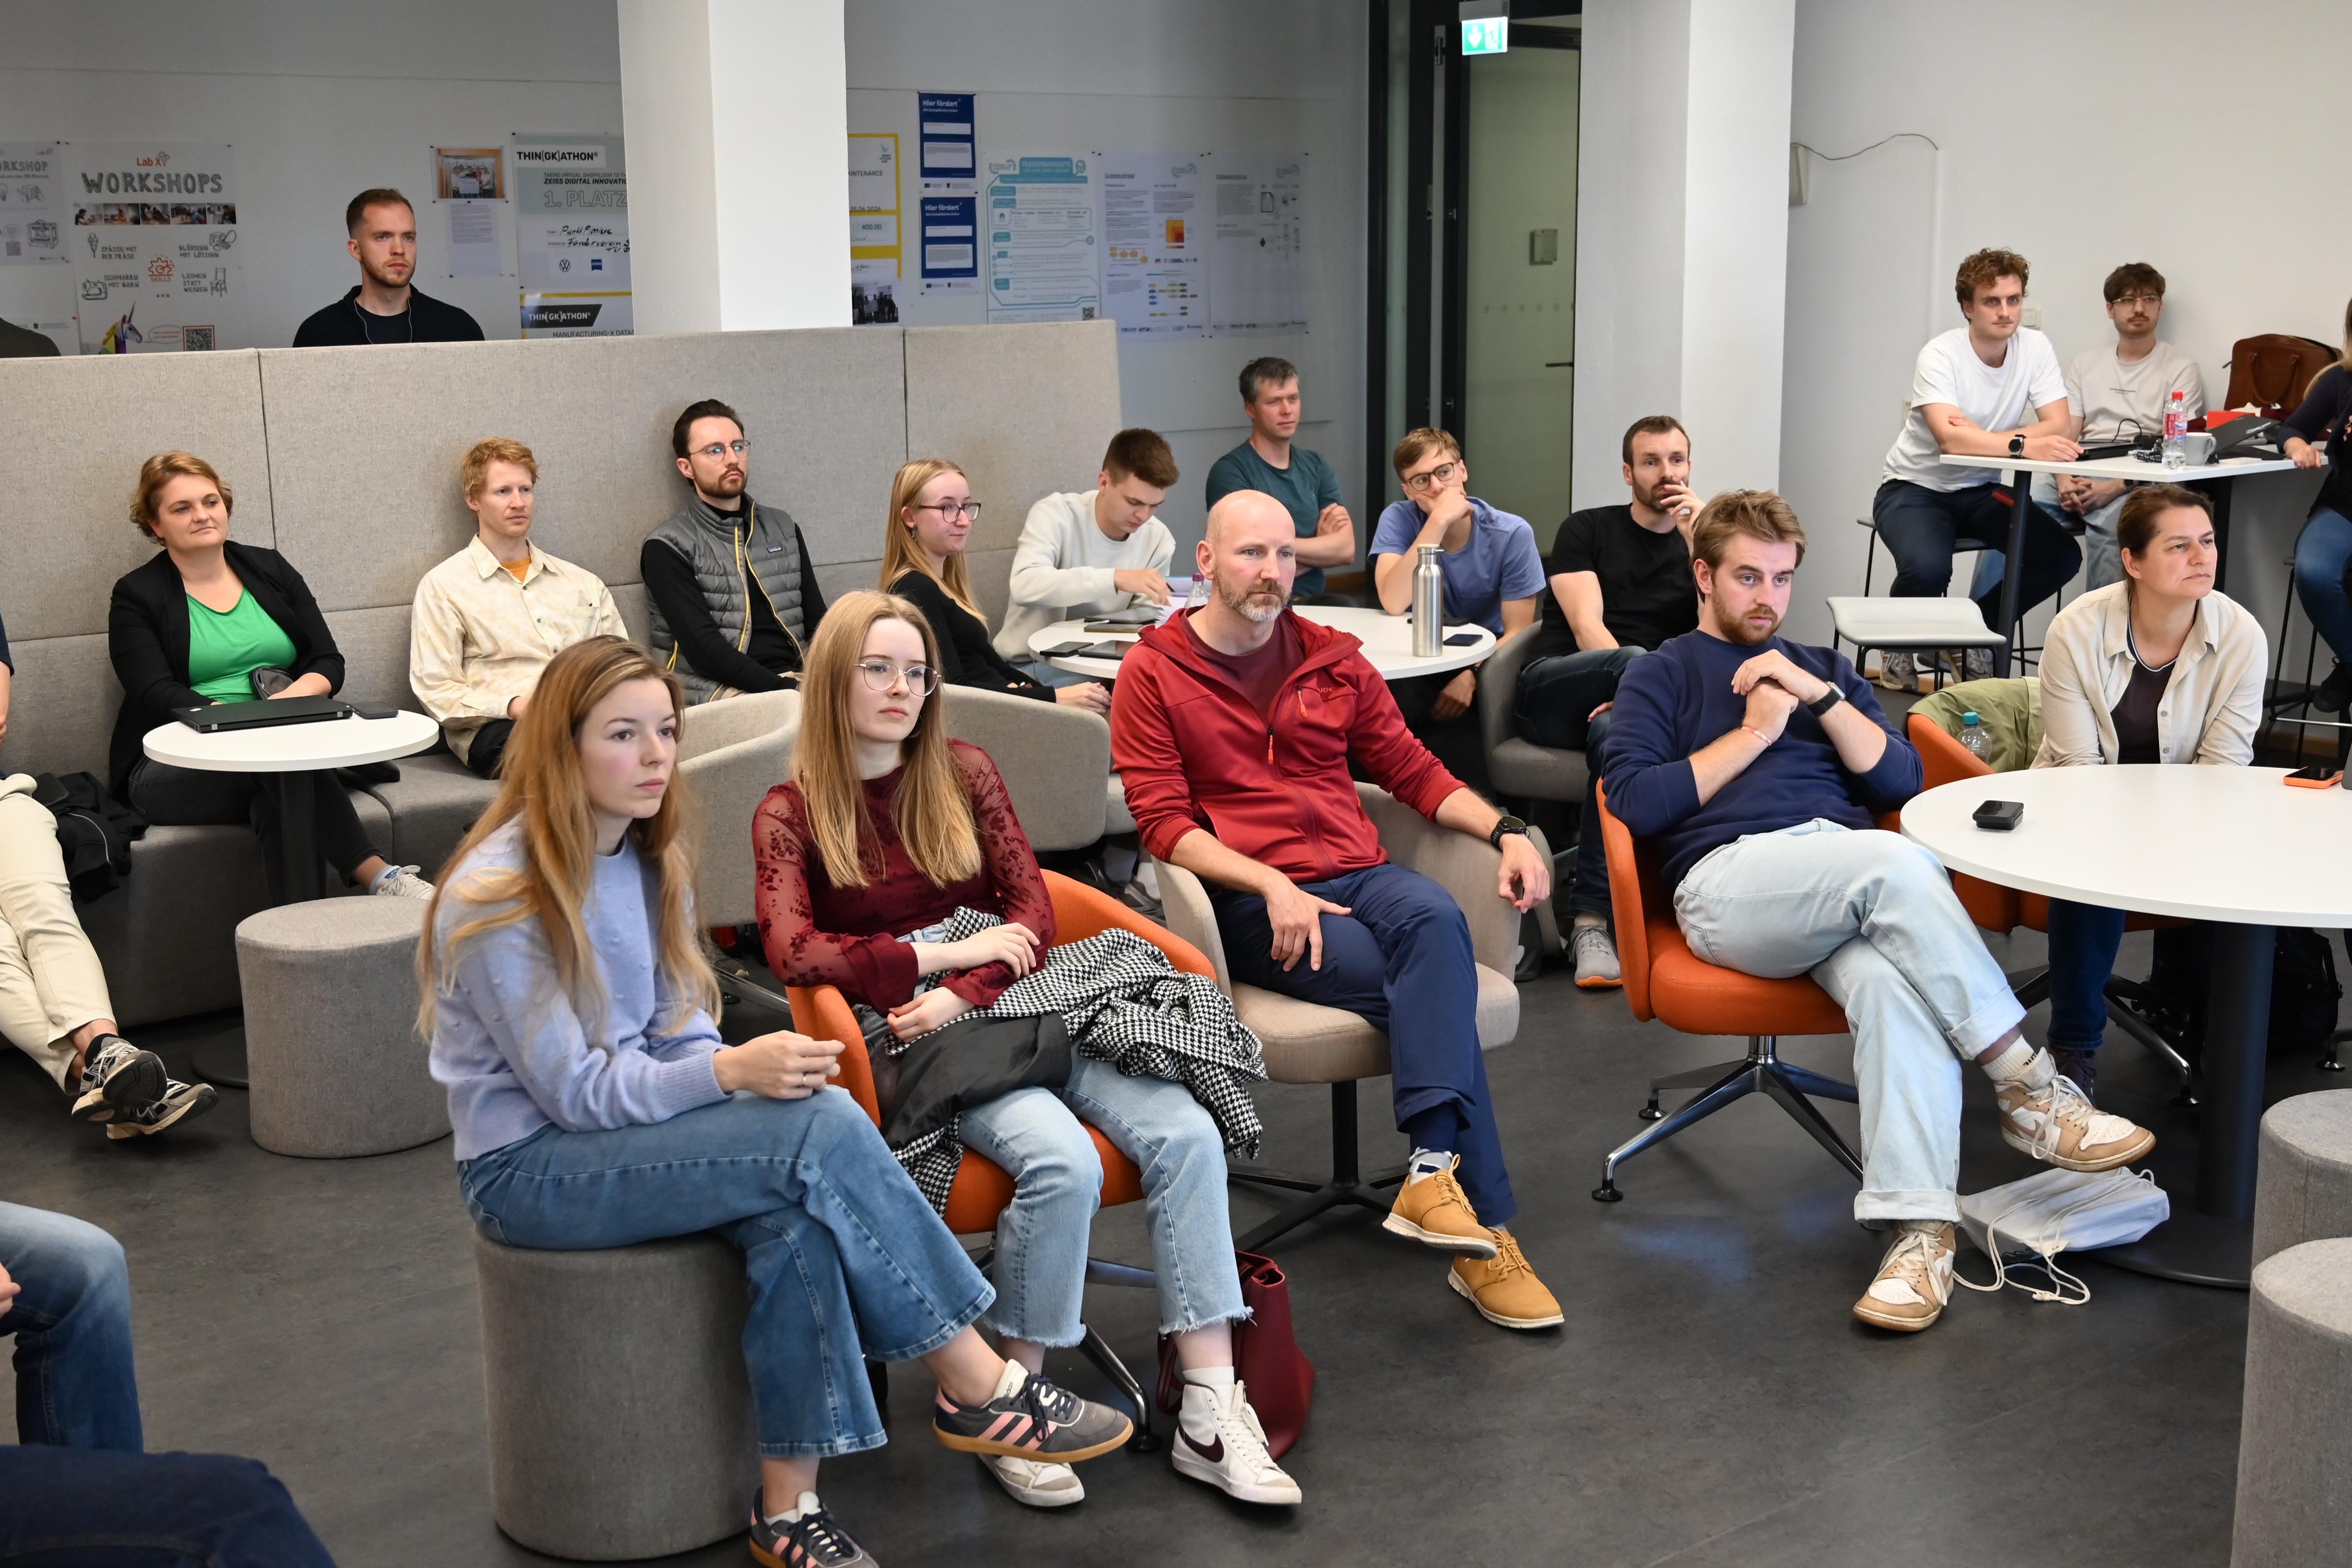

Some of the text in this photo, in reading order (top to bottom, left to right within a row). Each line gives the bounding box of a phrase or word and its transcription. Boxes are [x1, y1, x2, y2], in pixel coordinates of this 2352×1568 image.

[137, 157, 153, 166] Lab
[81, 172, 223, 194] WORKSHOPS
[544, 190, 628, 208] 1. PLATZ
